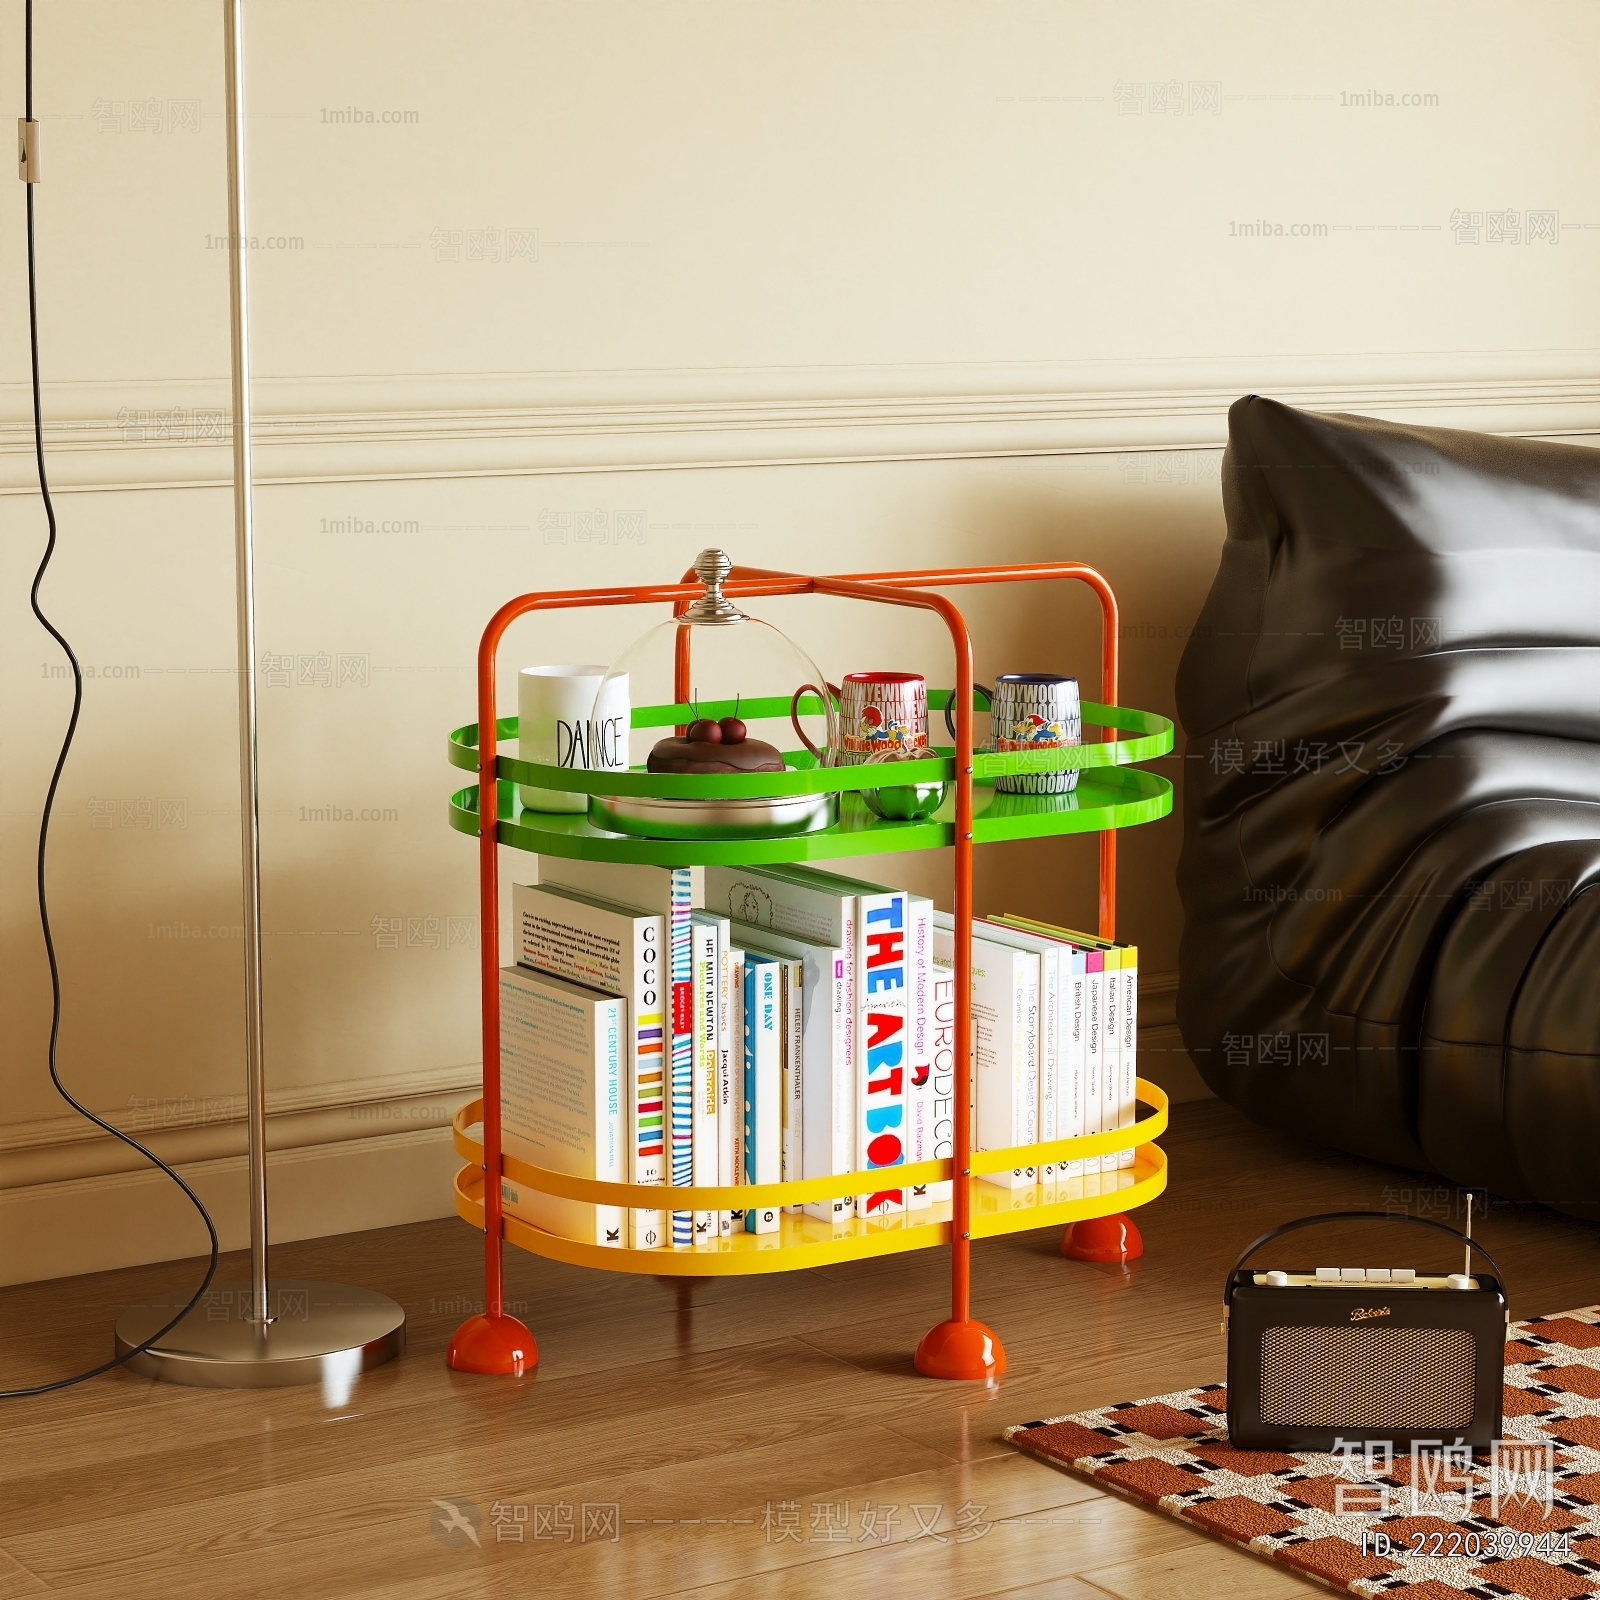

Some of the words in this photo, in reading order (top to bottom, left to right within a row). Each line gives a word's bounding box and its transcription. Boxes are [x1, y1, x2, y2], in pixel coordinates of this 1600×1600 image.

[845, 919, 853, 959] drawing
[867, 897, 904, 994] THE
[915, 917, 927, 956] History
[642, 926, 657, 1006] COCO
[916, 958, 926, 970] of
[1048, 971, 1056, 989] The
[764, 972, 773, 1000] ONE
[835, 981, 843, 1013] drawing
[916, 972, 926, 1015] Modern
[1028, 980, 1037, 1002] The
[1074, 982, 1082, 1010] British
[1090, 980, 1099, 1022] Japanese
[1109, 977, 1117, 1003] Italian
[1126, 975, 1134, 1016] American
[764, 1003, 773, 1031] DAY
[1016, 988, 1024, 1023] Ceramics
[1047, 991, 1056, 1054] Architectural
[1107, 1005, 1117, 1035] Design
[845, 1017, 853, 1066] designers
[914, 1017, 926, 1055] Design
[1026, 1005, 1037, 1067] Storyboard
[1072, 1012, 1082, 1041] Design
[1090, 1023, 1099, 1053] Design
[1124, 1018, 1134, 1048] Design
[607, 1026, 618, 1076] CENTURY
[720, 1050, 729, 1077] Jacqui
[867, 1013, 904, 1095] ART
[1026, 1070, 1036, 1106] Design
[1045, 1058, 1055, 1100] Drawing
[608, 1079, 618, 1116] HOUSE
[916, 1101, 924, 1126] David
[1027, 1110, 1036, 1145] Cours
[1046, 1102, 1054, 1137] Course
[916, 1126, 924, 1162] Raizman
